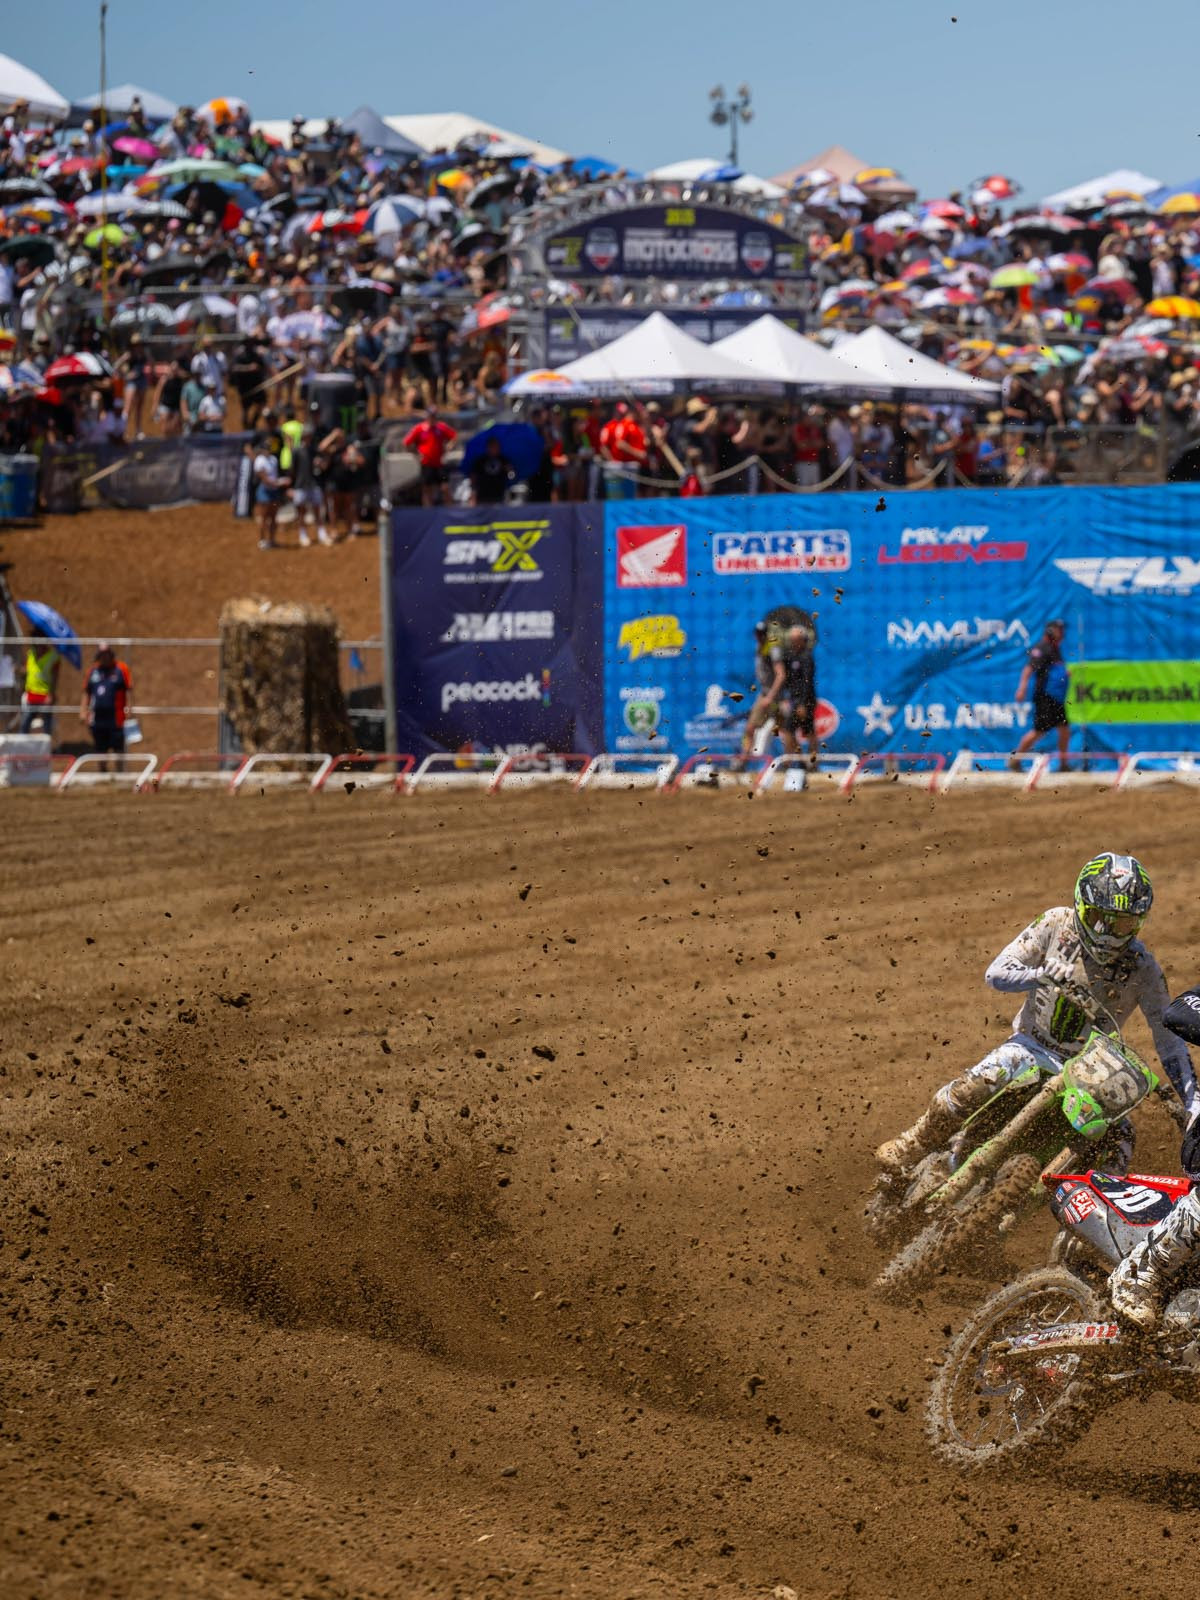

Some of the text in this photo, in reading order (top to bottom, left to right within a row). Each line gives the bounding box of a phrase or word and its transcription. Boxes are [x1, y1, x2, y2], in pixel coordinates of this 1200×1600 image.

[443, 530, 543, 572] SMX
[717, 535, 845, 556] PARTS
[716, 555, 846, 572] UNLIMITED
[441, 672, 542, 713] peacock
[954, 702, 1032, 729] ARMY
[1131, 1173, 1180, 1186] HONDA
[1101, 1185, 1163, 1213] 10
